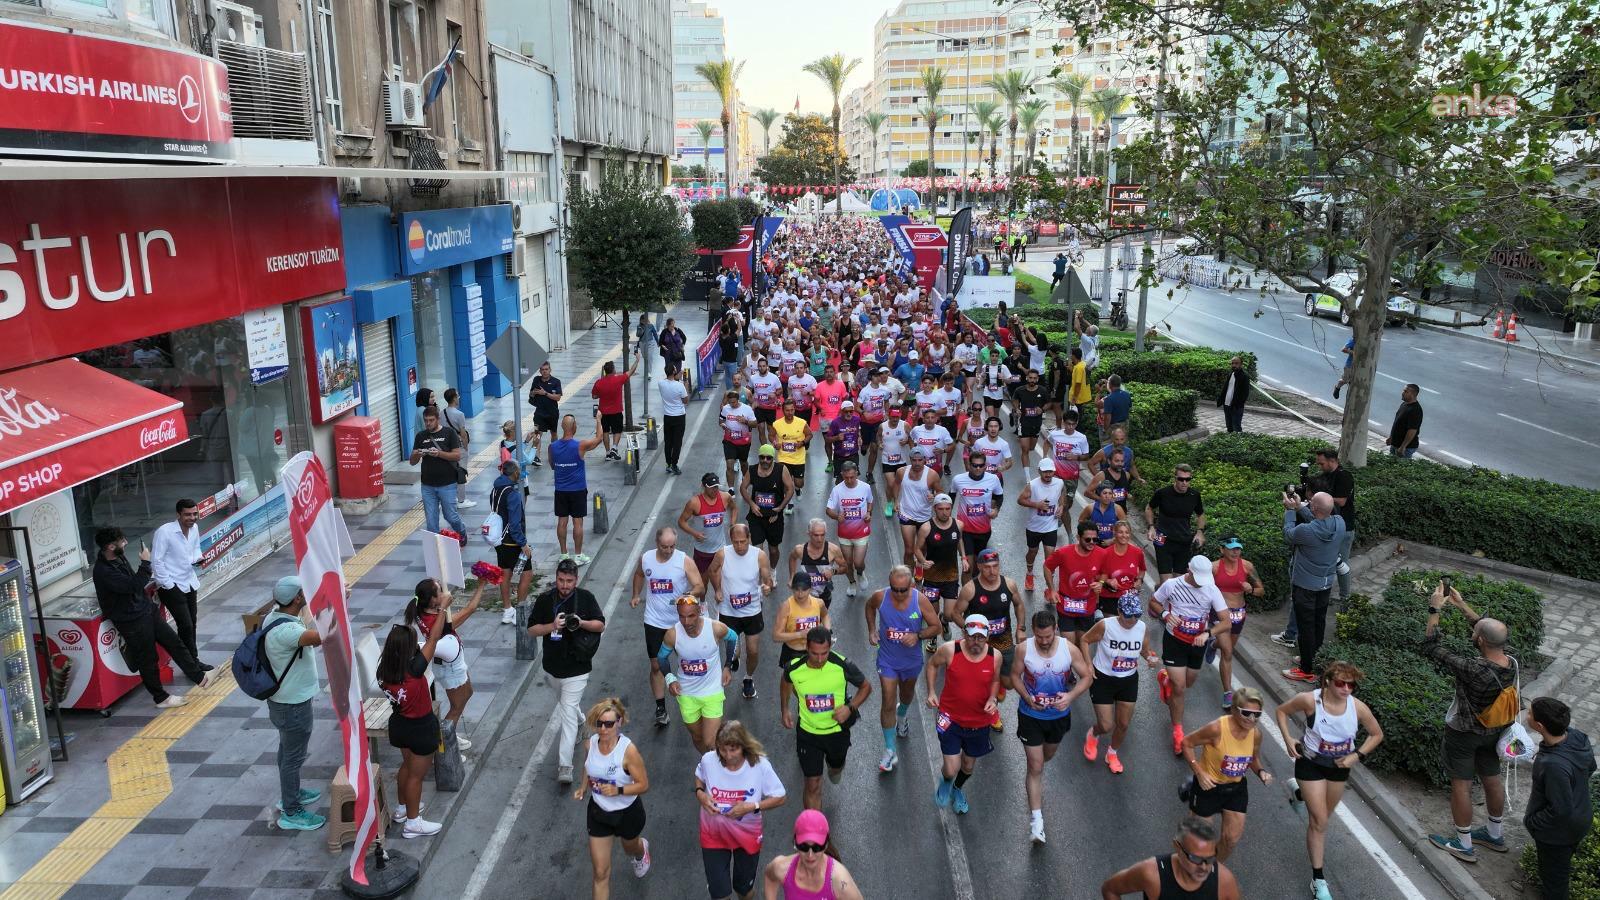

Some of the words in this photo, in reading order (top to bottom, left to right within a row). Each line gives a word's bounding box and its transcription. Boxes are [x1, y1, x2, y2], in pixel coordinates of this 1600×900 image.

[99, 79, 178, 106] AIRLINES
[164, 143, 179, 151] STAR
[180, 144, 203, 153] ALLIANCE
[953, 233, 962, 269] TIMING
[266, 252, 309, 273] KERENSOY
[310, 246, 340, 265] TURİZM
[18, 463, 62, 493] SHOP
[732, 597, 749, 606] 1379
[1066, 601, 1084, 609] 2843
[1229, 611, 1243, 620] 015
[799, 621, 817, 630] 1748
[1180, 621, 1200, 629] 1548
[1109, 639, 1141, 650] BOLD
[809, 699, 831, 708] 1358
